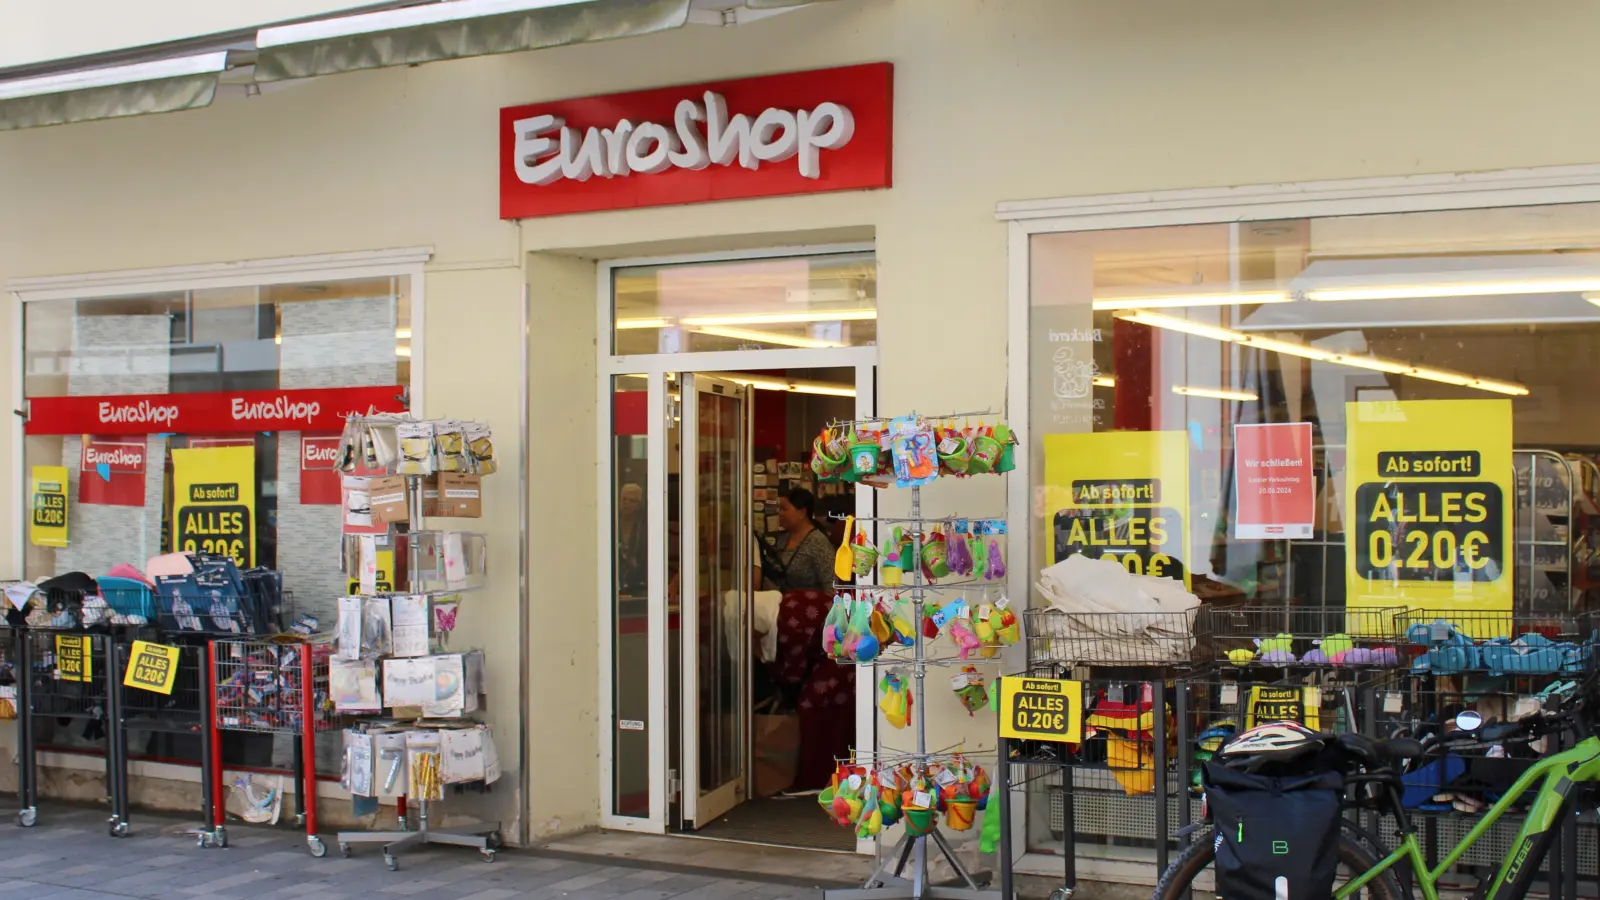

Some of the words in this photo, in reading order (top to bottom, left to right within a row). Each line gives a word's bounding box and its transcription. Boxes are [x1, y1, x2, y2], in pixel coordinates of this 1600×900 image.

[1244, 459, 1259, 468] Wir
[1385, 456, 1410, 473] Ab
[1413, 455, 1472, 473] sofort!
[193, 487, 206, 499] Ab
[206, 485, 235, 499] sofort!
[1079, 485, 1100, 499] Ab
[1103, 484, 1154, 499] sofort!
[36, 496, 64, 509] ALLES
[1369, 491, 1488, 523] ALLES
[36, 509, 63, 524] 0.20€
[185, 512, 243, 535] ALLES
[1066, 517, 1169, 546] ALLES
[1369, 529, 1489, 569] 0.20€
[139, 655, 168, 670] ALLES
[135, 667, 166, 684] 0.20€
[1025, 682, 1035, 690] Ab
[1036, 683, 1059, 692] sofort!
[1018, 696, 1064, 712] ALLES
[1256, 705, 1298, 719] ALLES
[1017, 711, 1064, 730] 0.20€
[1505, 838, 1534, 884] CUBE
